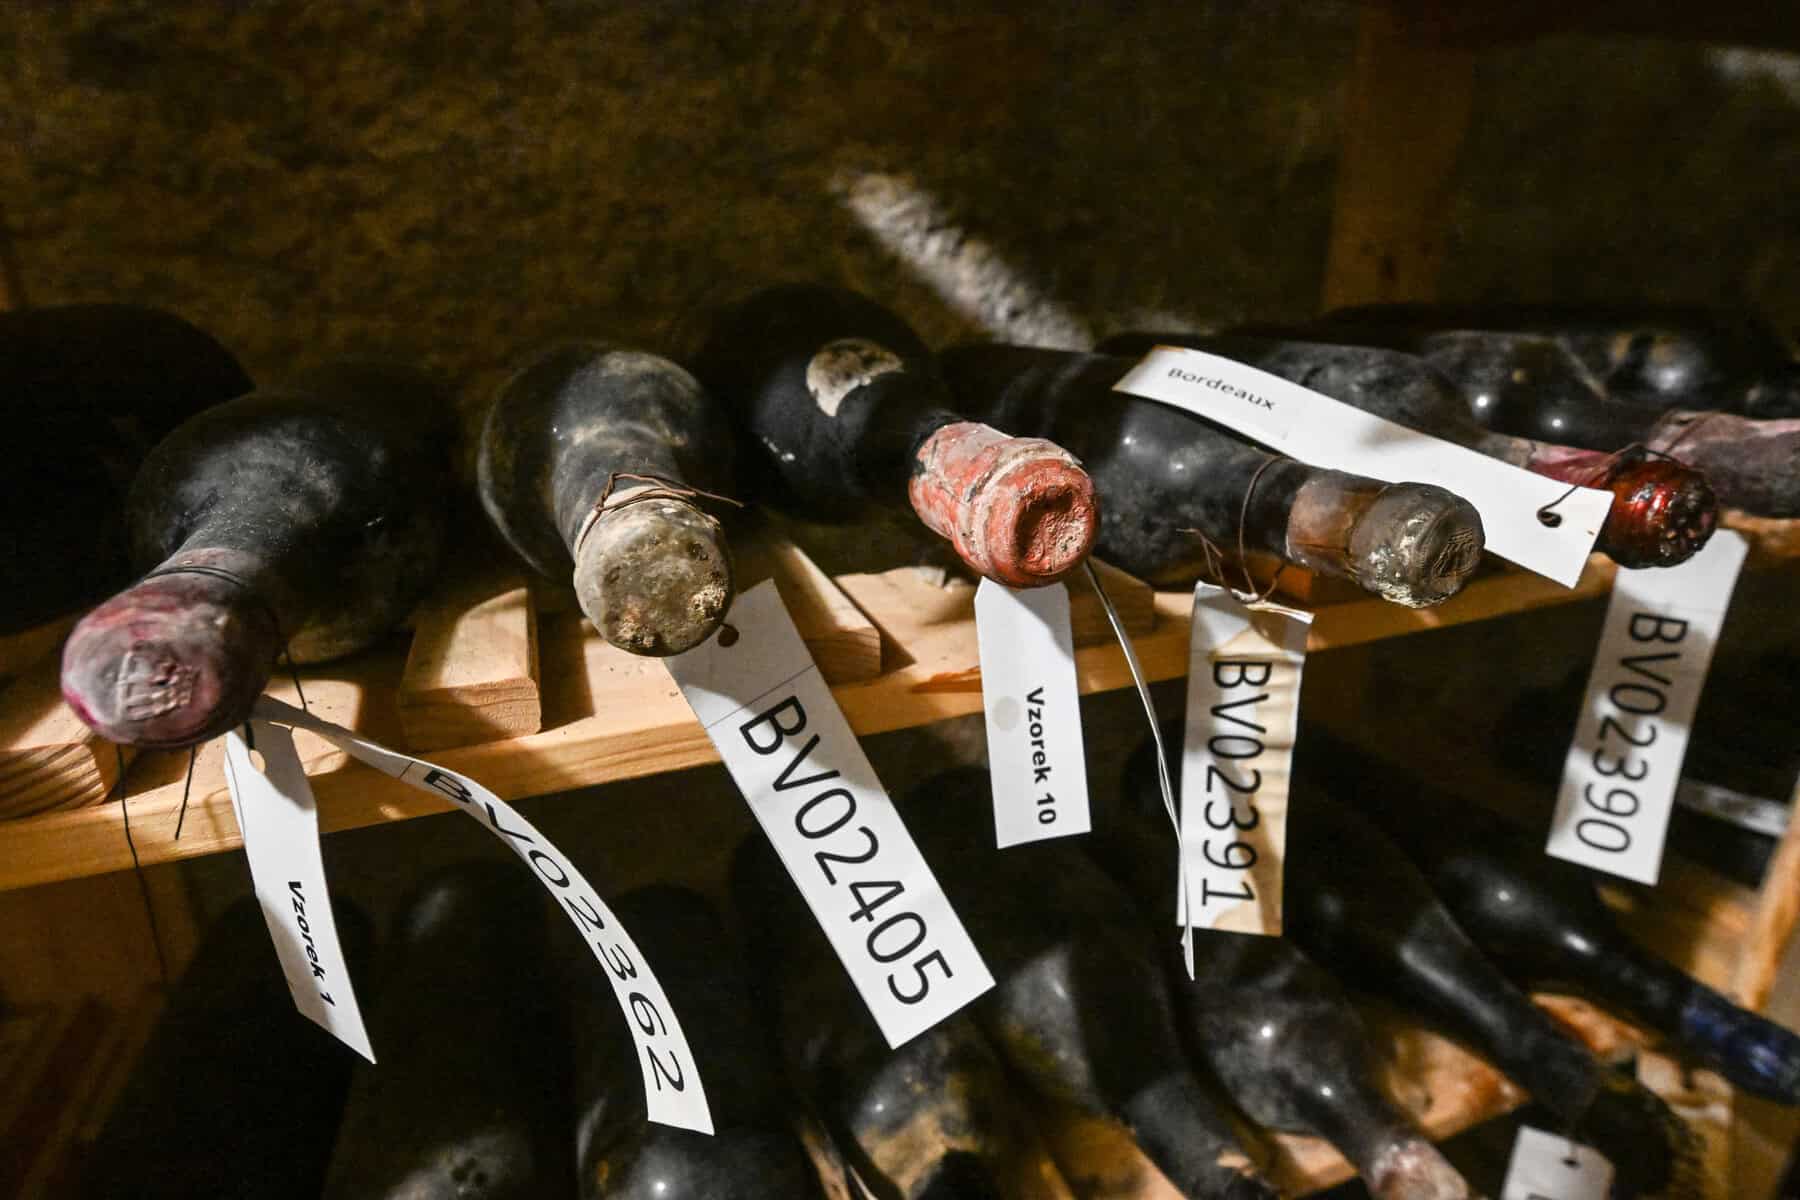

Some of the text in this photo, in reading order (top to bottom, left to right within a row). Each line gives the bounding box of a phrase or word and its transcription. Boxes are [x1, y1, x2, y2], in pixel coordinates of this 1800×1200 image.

[1167, 366, 1276, 412] Bordeaux
[739, 695, 953, 1006] BV02405
[1026, 687, 1057, 825] Vzorek 10
[1200, 660, 1273, 907] BV02391
[1574, 612, 1689, 855] BV02390
[286, 880, 337, 1007] Vzorek 1
[423, 769, 685, 1093] BV02362
